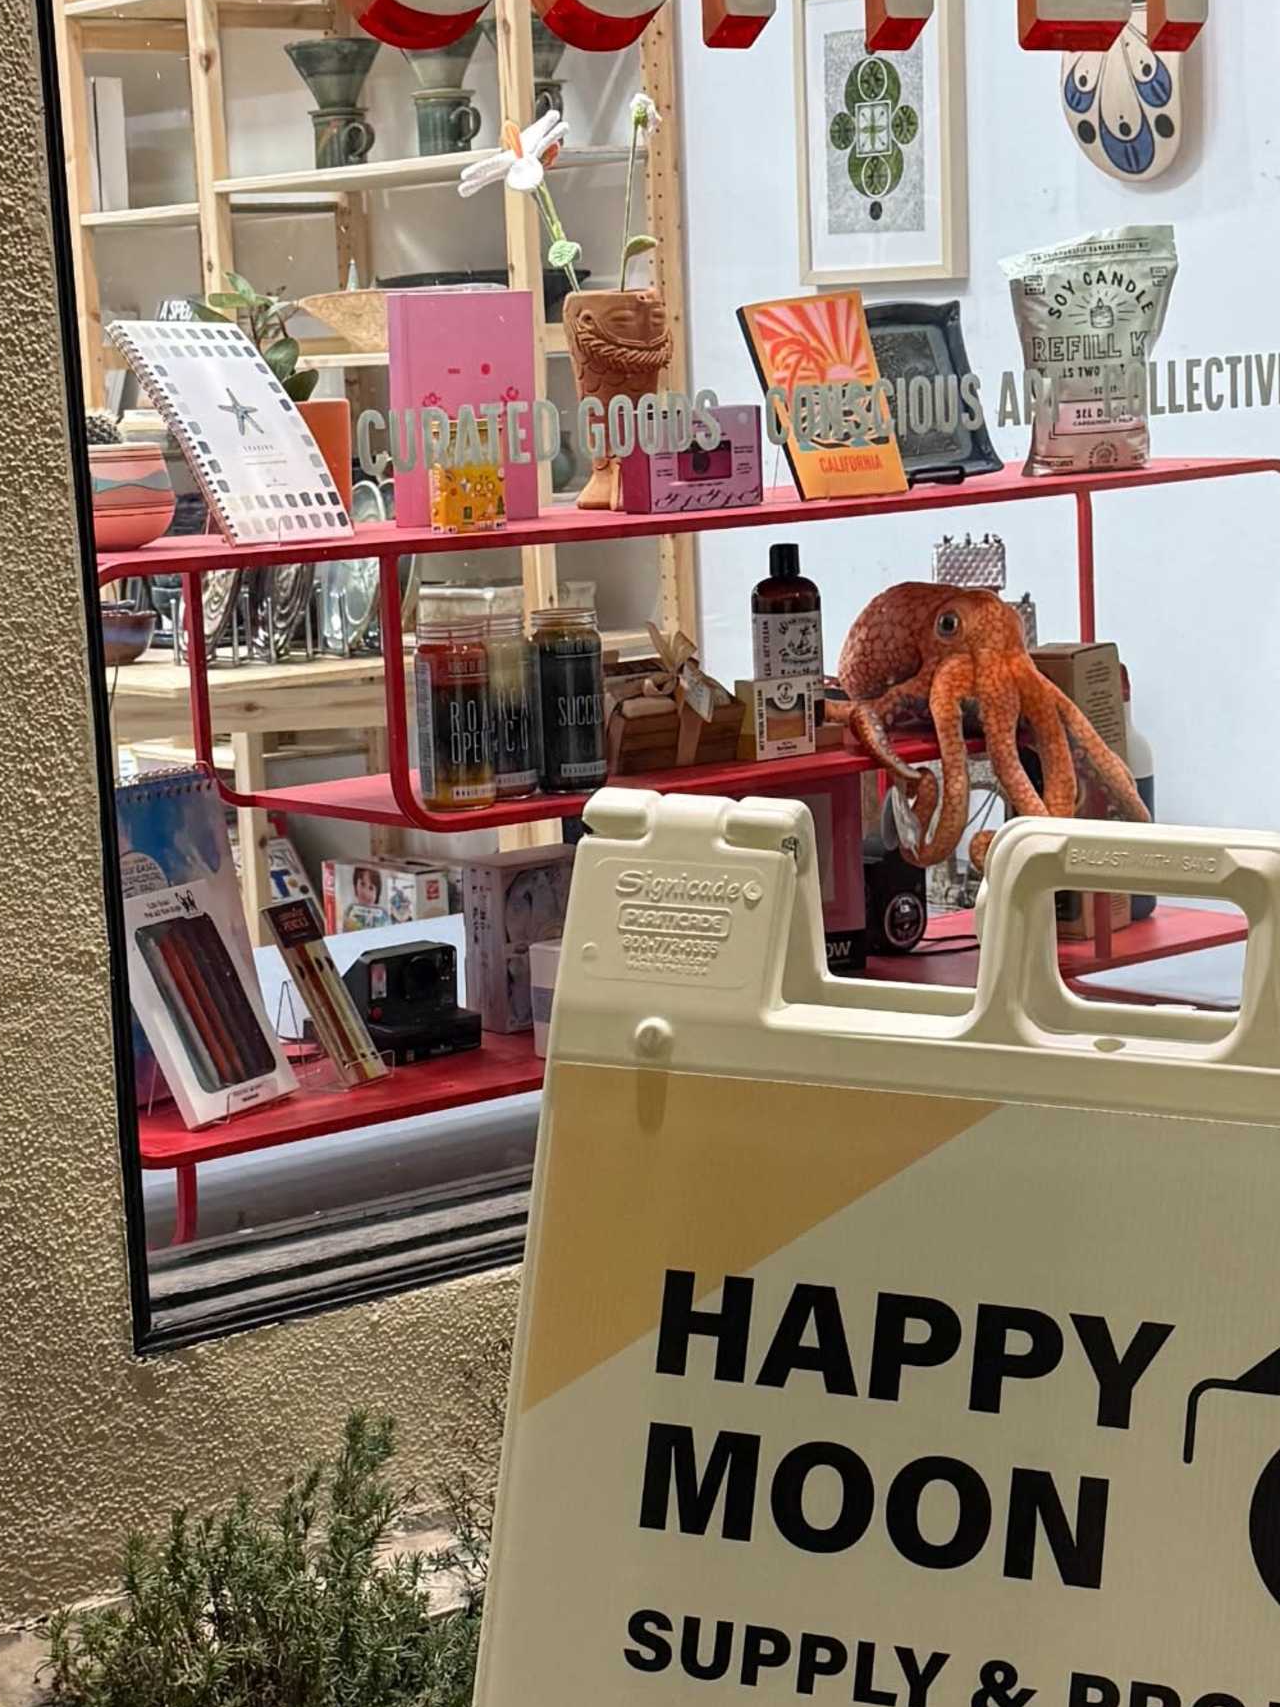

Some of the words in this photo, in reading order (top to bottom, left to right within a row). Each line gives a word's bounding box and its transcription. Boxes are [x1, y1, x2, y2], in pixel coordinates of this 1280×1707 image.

[1048, 279, 1076, 320] SOY
[1083, 269, 1154, 315] CANDLE
[1032, 332, 1122, 363] REFILL
[357, 398, 561, 477] CURATED
[577, 388, 721, 459] GOODS
[764, 373, 981, 447] CONSCIOUS
[819, 455, 883, 475] CALIFORNIA
[1070, 847, 1127, 867] BALLAST
[1138, 853, 1172, 871] WITH
[1181, 856, 1217, 874] SAND
[655, 1268, 1176, 1430] HAPPY
[638, 1422, 1110, 1590] MOON
